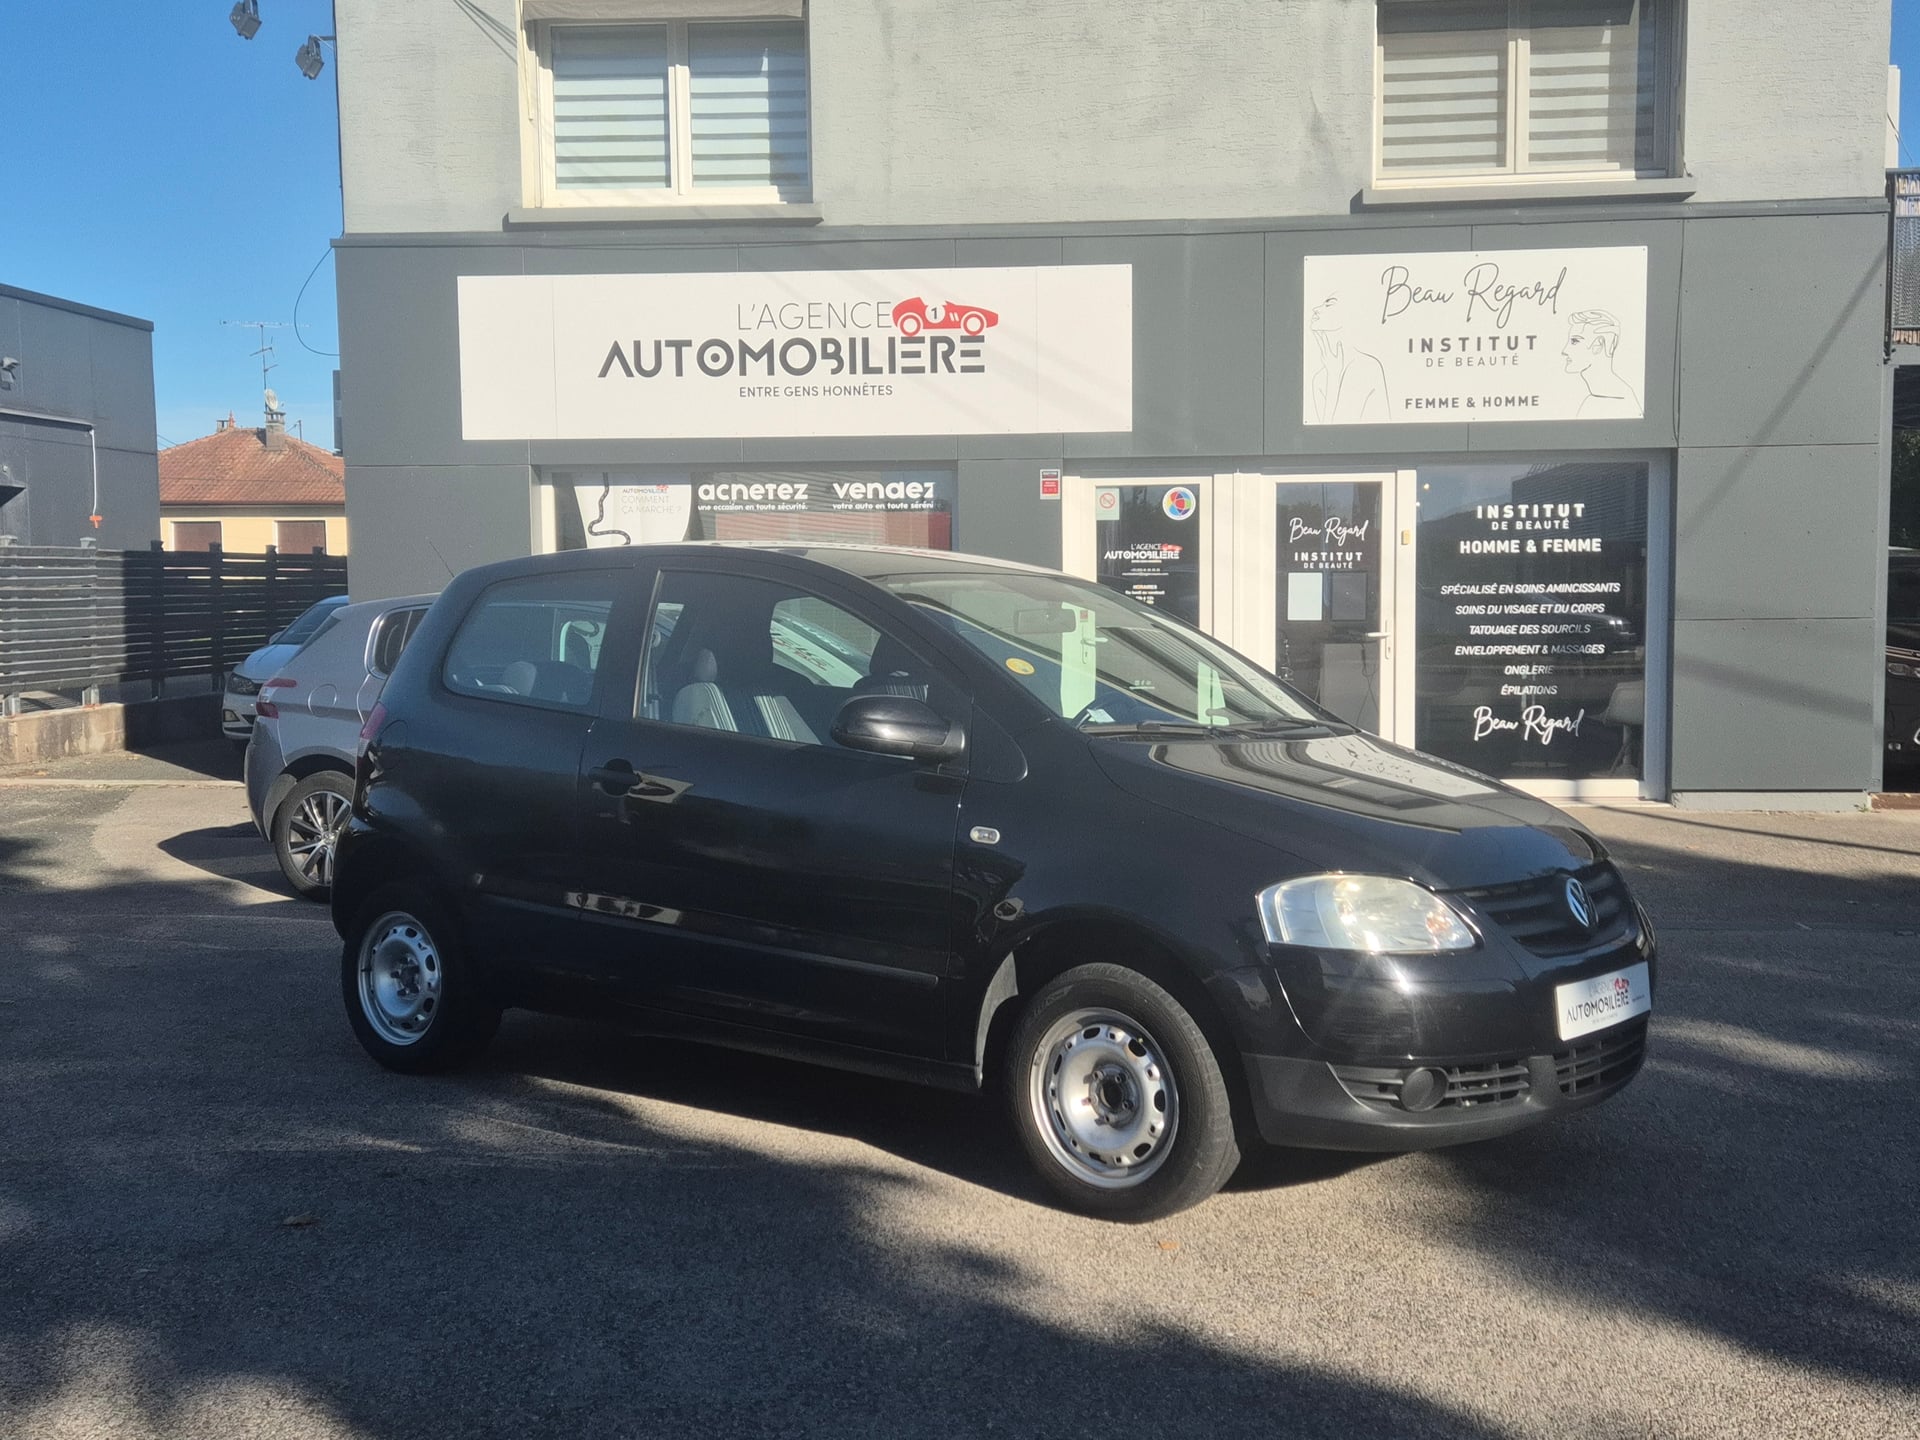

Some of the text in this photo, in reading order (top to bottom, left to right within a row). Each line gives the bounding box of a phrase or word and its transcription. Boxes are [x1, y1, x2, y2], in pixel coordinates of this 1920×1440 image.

[1381, 262, 1568, 329] Beau Regard
[737, 301, 893, 331] L'AGENCE
[1408, 335, 1538, 354] INSTITUT
[1425, 354, 1520, 368] DE BEAUTÉ
[738, 382, 894, 399] ENTRE GENS HONNÊTES
[1405, 395, 1540, 409] FEMME & HOMME
[1476, 503, 1585, 520] INSTITUT
[1289, 516, 1369, 547] Beau Regard
[1491, 519, 1570, 531] DE BEAUTÉ
[1459, 537, 1602, 554] HOMME & FEMME
[1294, 551, 1363, 562] INSTITUT
[1318, 561, 1353, 569] BEAUTÉ
[1440, 582, 1621, 595] SPÉCIALISÉ EN SOINS AMINCISSANTS
[1455, 603, 1606, 615] SOINS DU VISAGE ET DU CORPS
[1469, 623, 1592, 635] TATOUAGE DES SOURCILS
[1454, 643, 1606, 656] ENVELOPPEMENT & MASSAGES
[1504, 664, 1554, 675] ONGLERIE
[1500, 683, 1558, 696] ÉPILATIONS
[1473, 704, 1585, 745] Beau Regard
